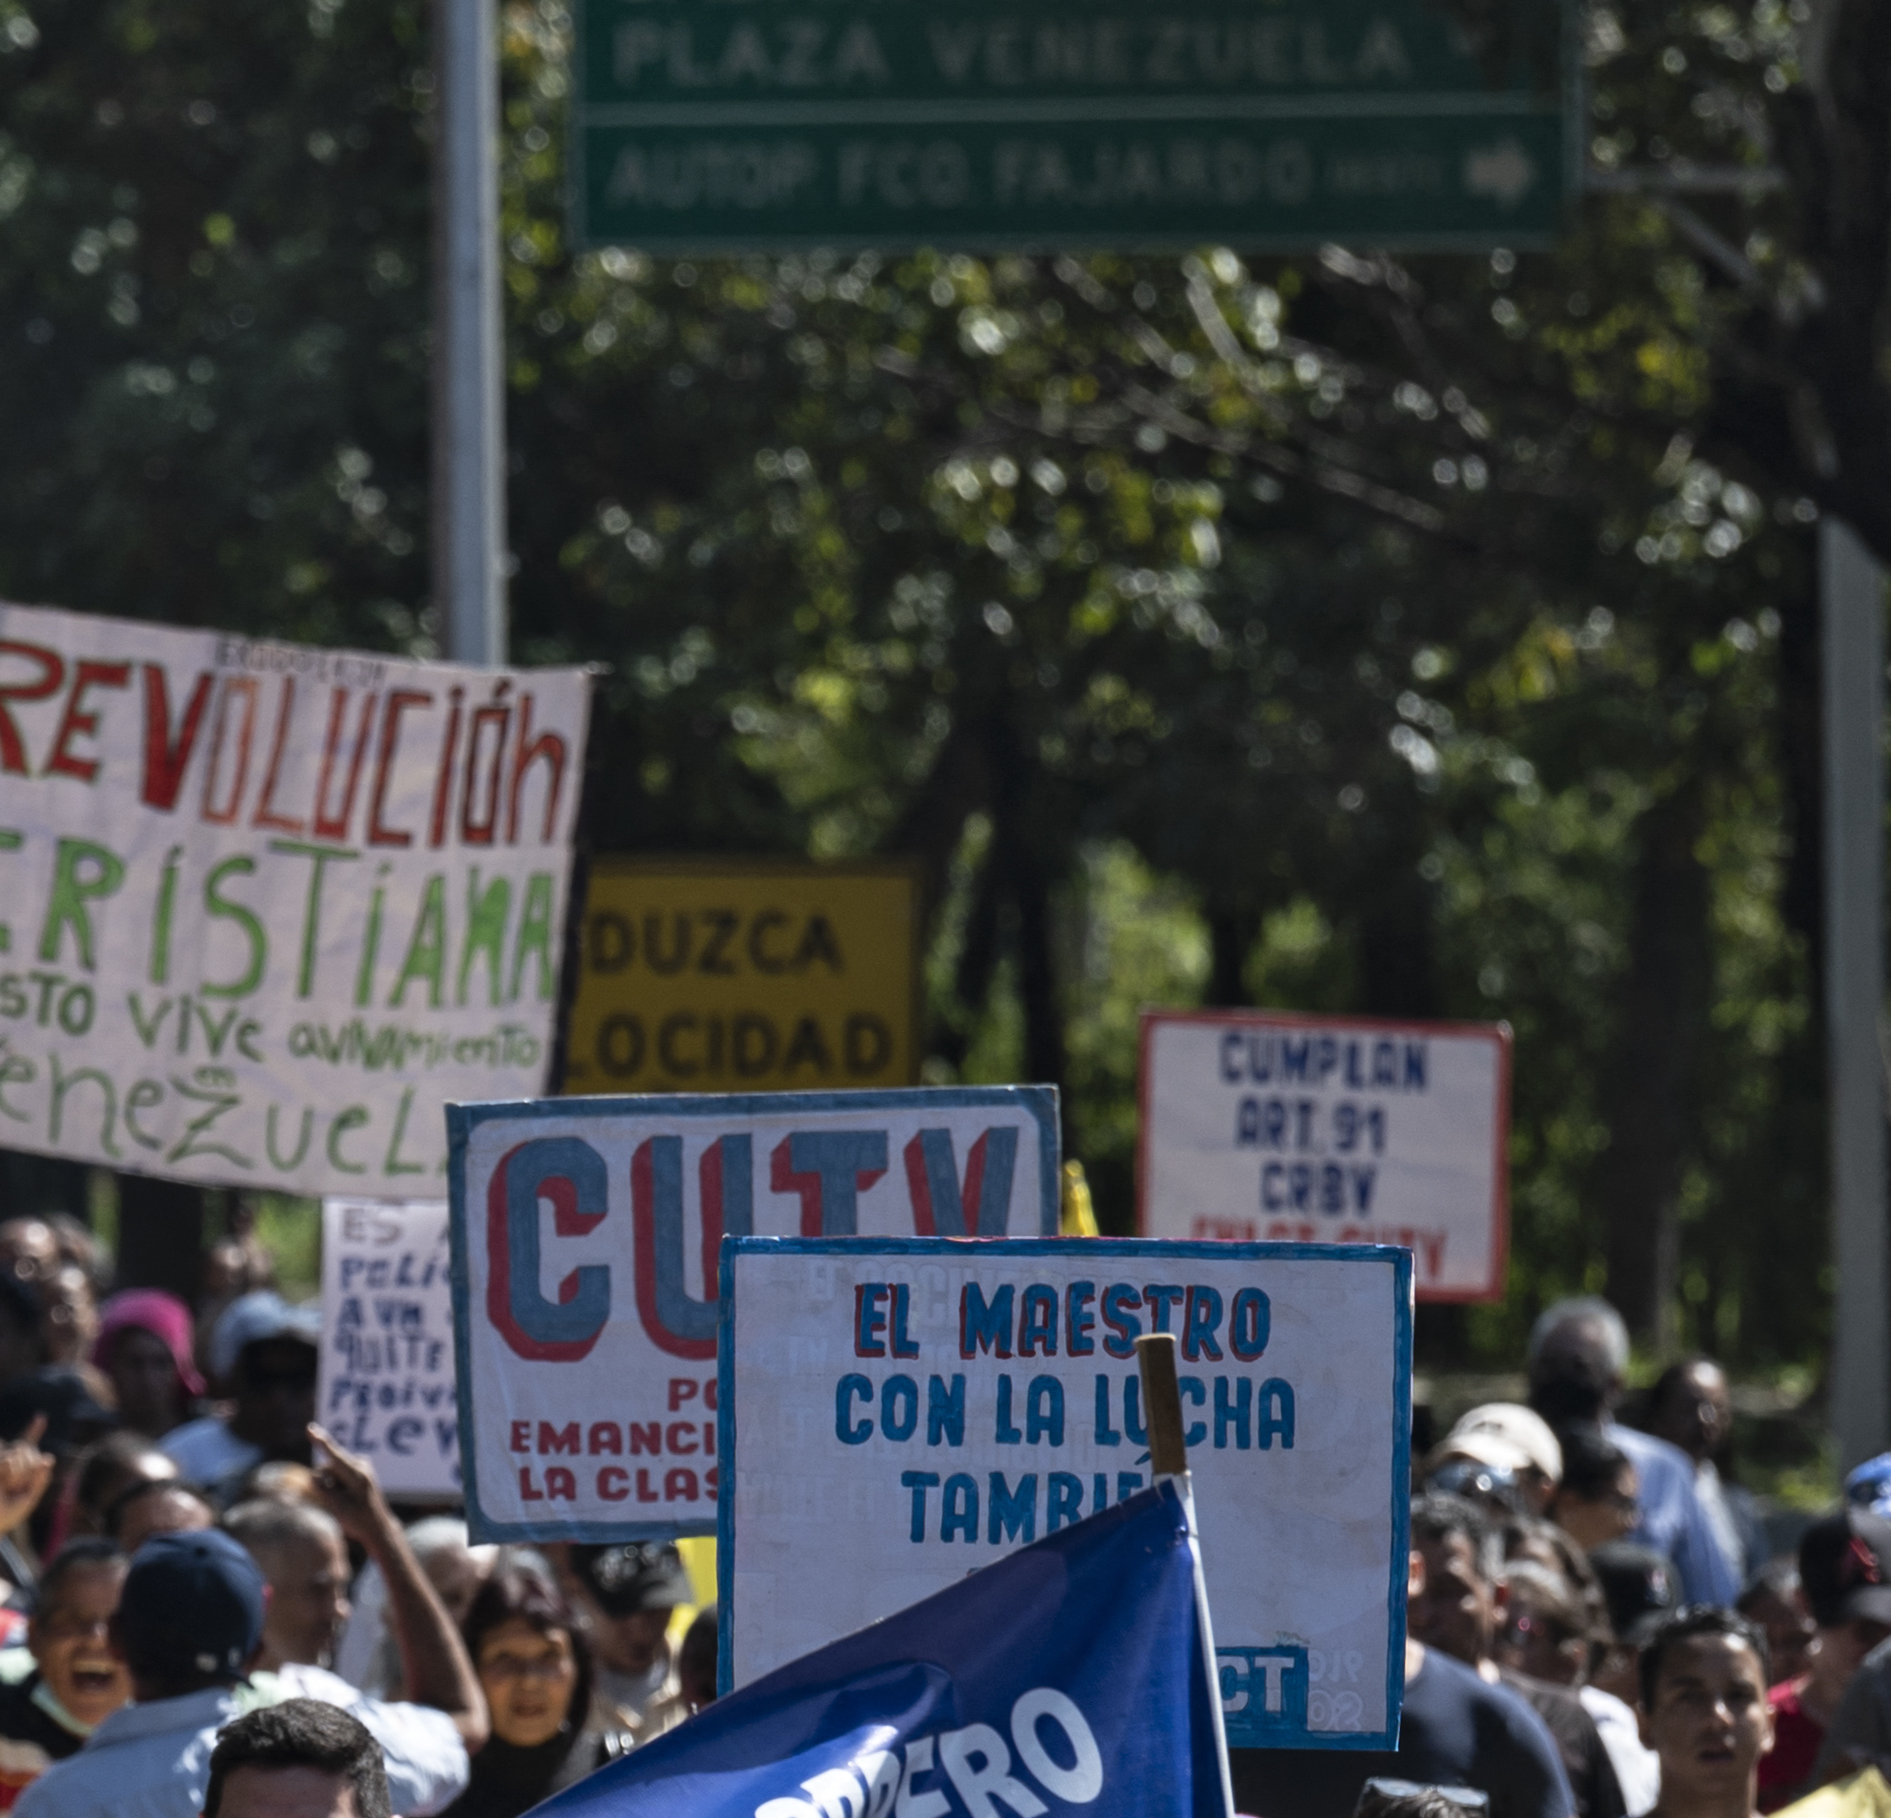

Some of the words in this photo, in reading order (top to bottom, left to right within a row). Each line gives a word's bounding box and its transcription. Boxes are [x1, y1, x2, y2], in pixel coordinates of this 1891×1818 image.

[616, 19, 893, 86] PLAZA
[929, 19, 1414, 85] VENEZUELA
[589, 908, 849, 977] DUZCA
[1219, 1032, 1430, 1092] CUMPLAN
[854, 1282, 919, 1358] EL
[960, 1281, 1271, 1362] MAESTRO
[510, 1421, 716, 1456] EMANCI
[835, 1373, 966, 1447] CON
[996, 1374, 1065, 1447] LA
[1095, 1375, 1295, 1450] LUCHA
[520, 1467, 576, 1503] LA
[597, 1466, 716, 1503] CLAS
